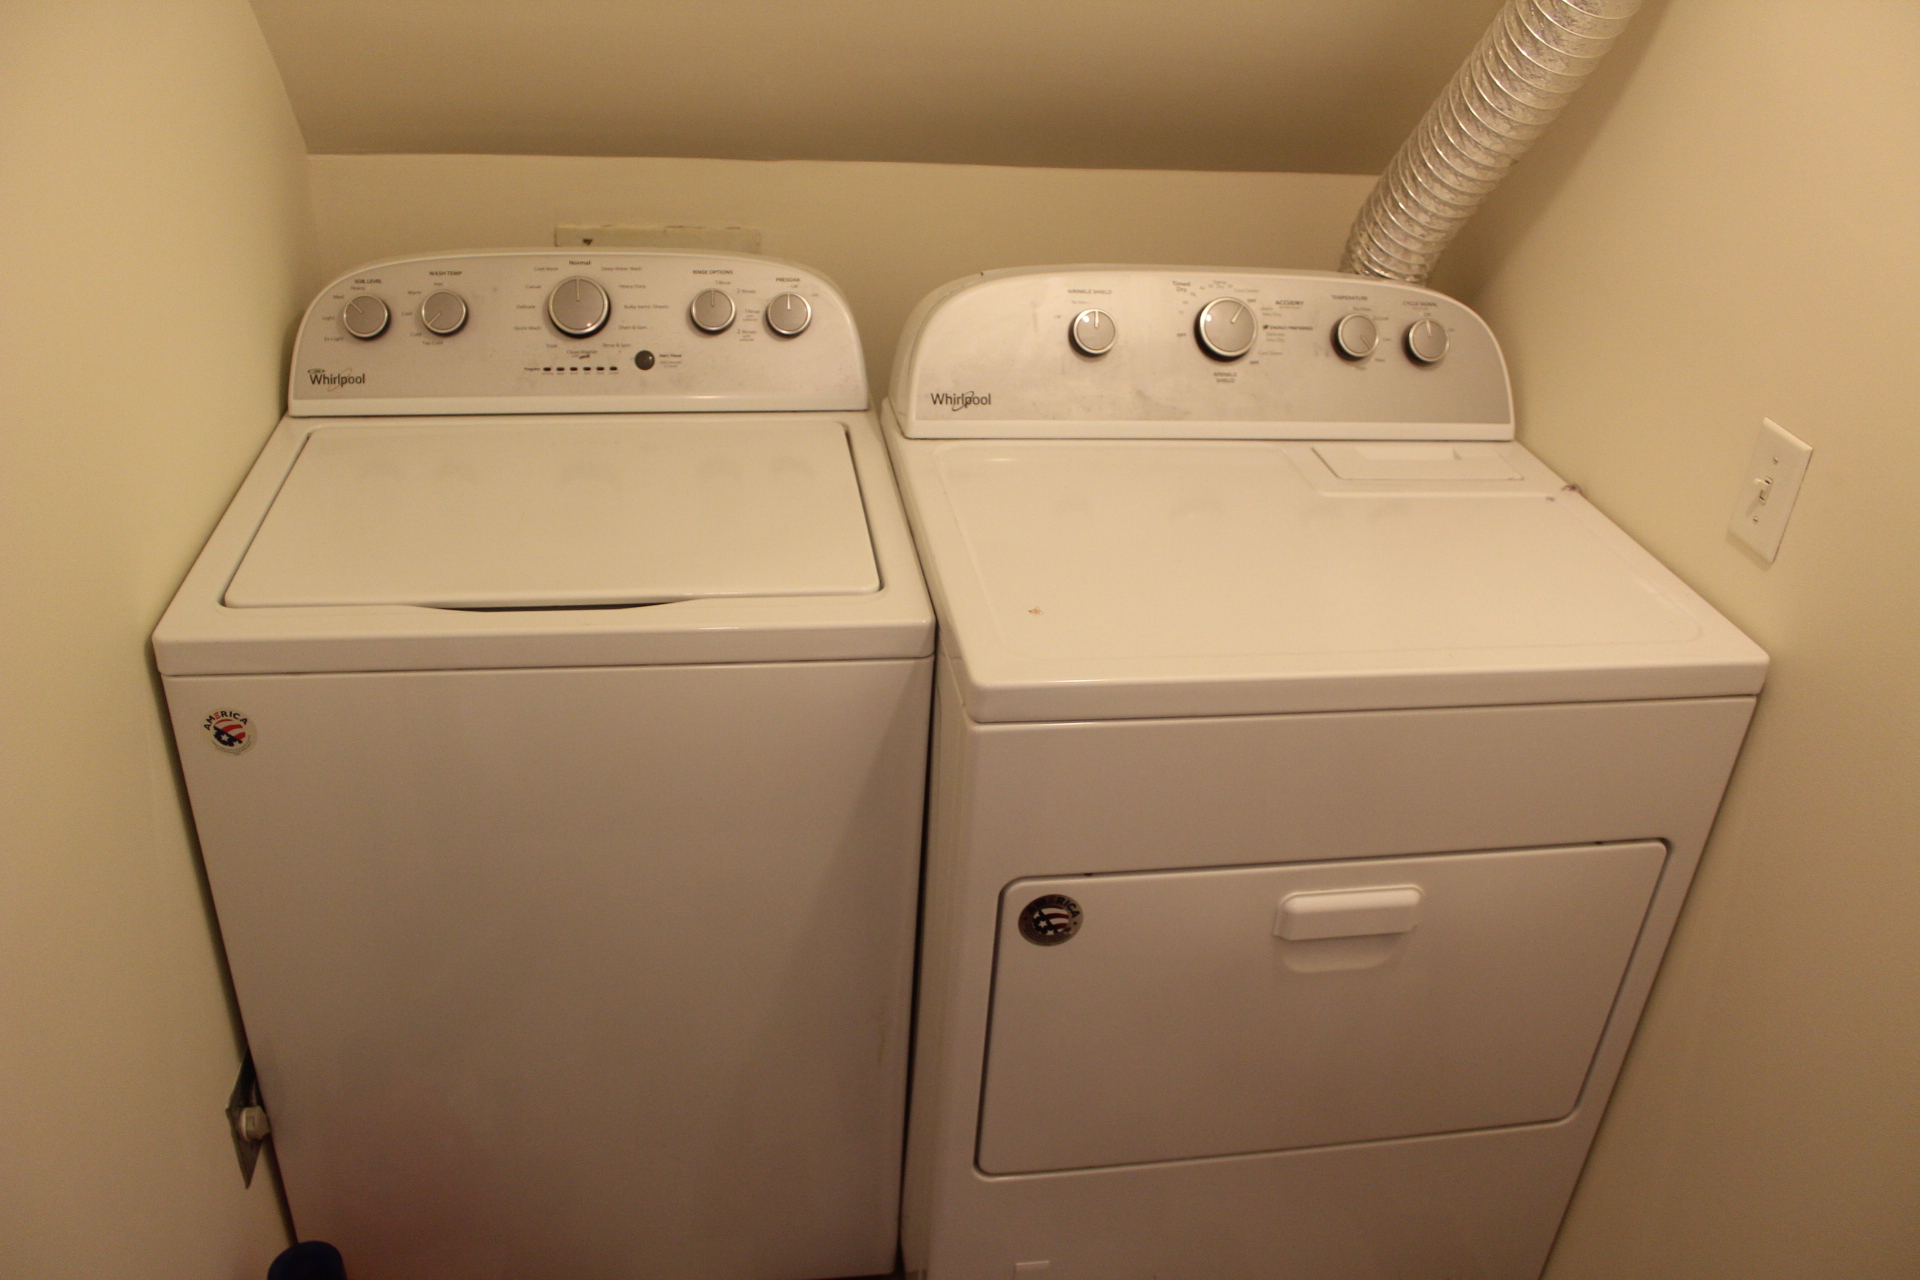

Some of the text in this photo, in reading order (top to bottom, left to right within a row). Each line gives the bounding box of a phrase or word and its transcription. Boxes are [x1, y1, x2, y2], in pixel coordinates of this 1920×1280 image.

[309, 373, 366, 387] Whirlpool
[930, 393, 991, 408] Whirlpool
[203, 710, 248, 731] AMERICA
